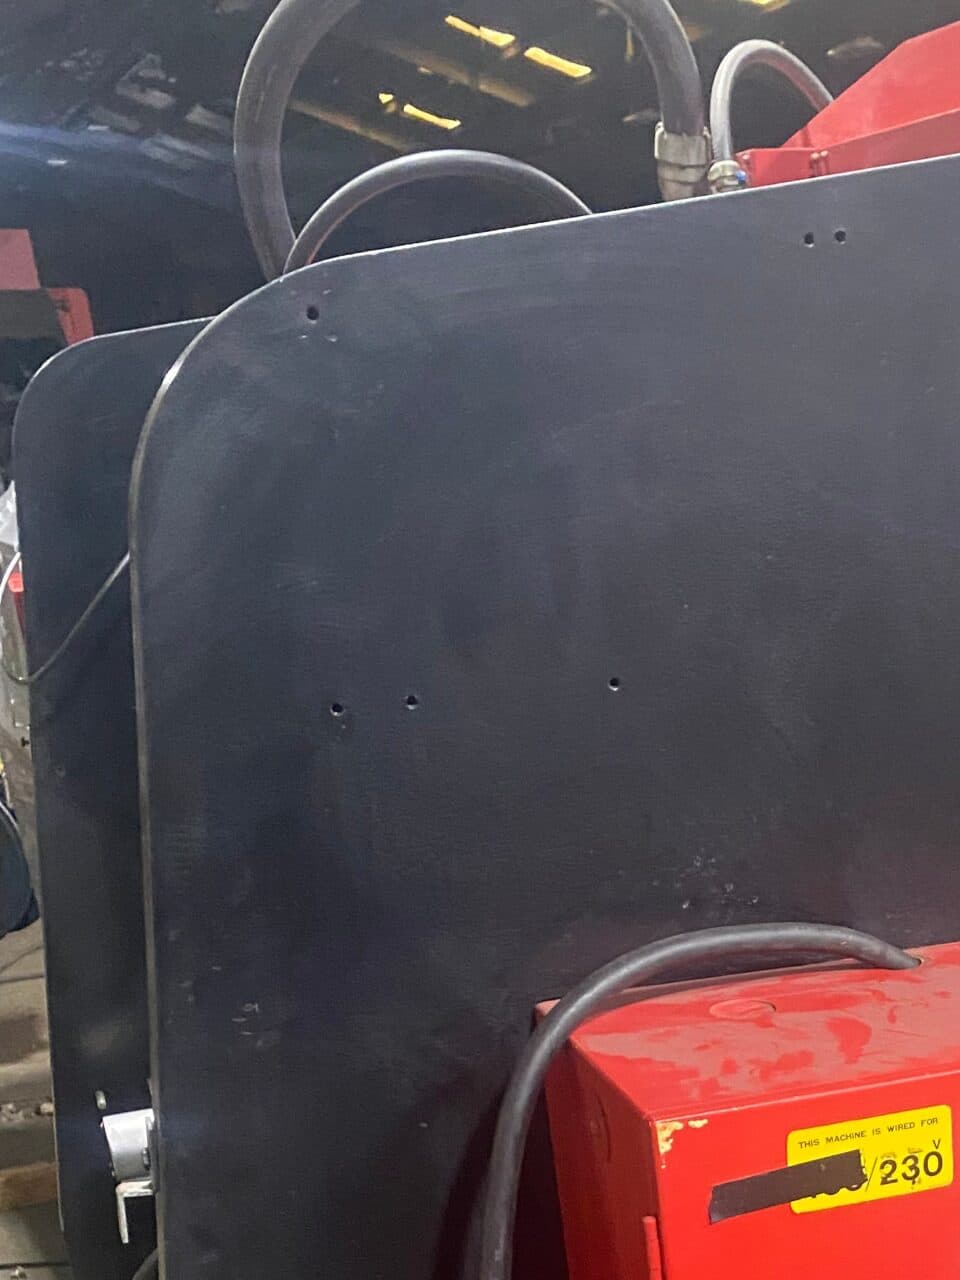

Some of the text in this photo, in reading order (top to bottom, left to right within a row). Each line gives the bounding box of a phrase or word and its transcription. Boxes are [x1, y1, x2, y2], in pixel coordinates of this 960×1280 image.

[797, 1117, 938, 1149] THIS MACHINE IS WIRED FOR
[932, 1138, 942, 1150] V
